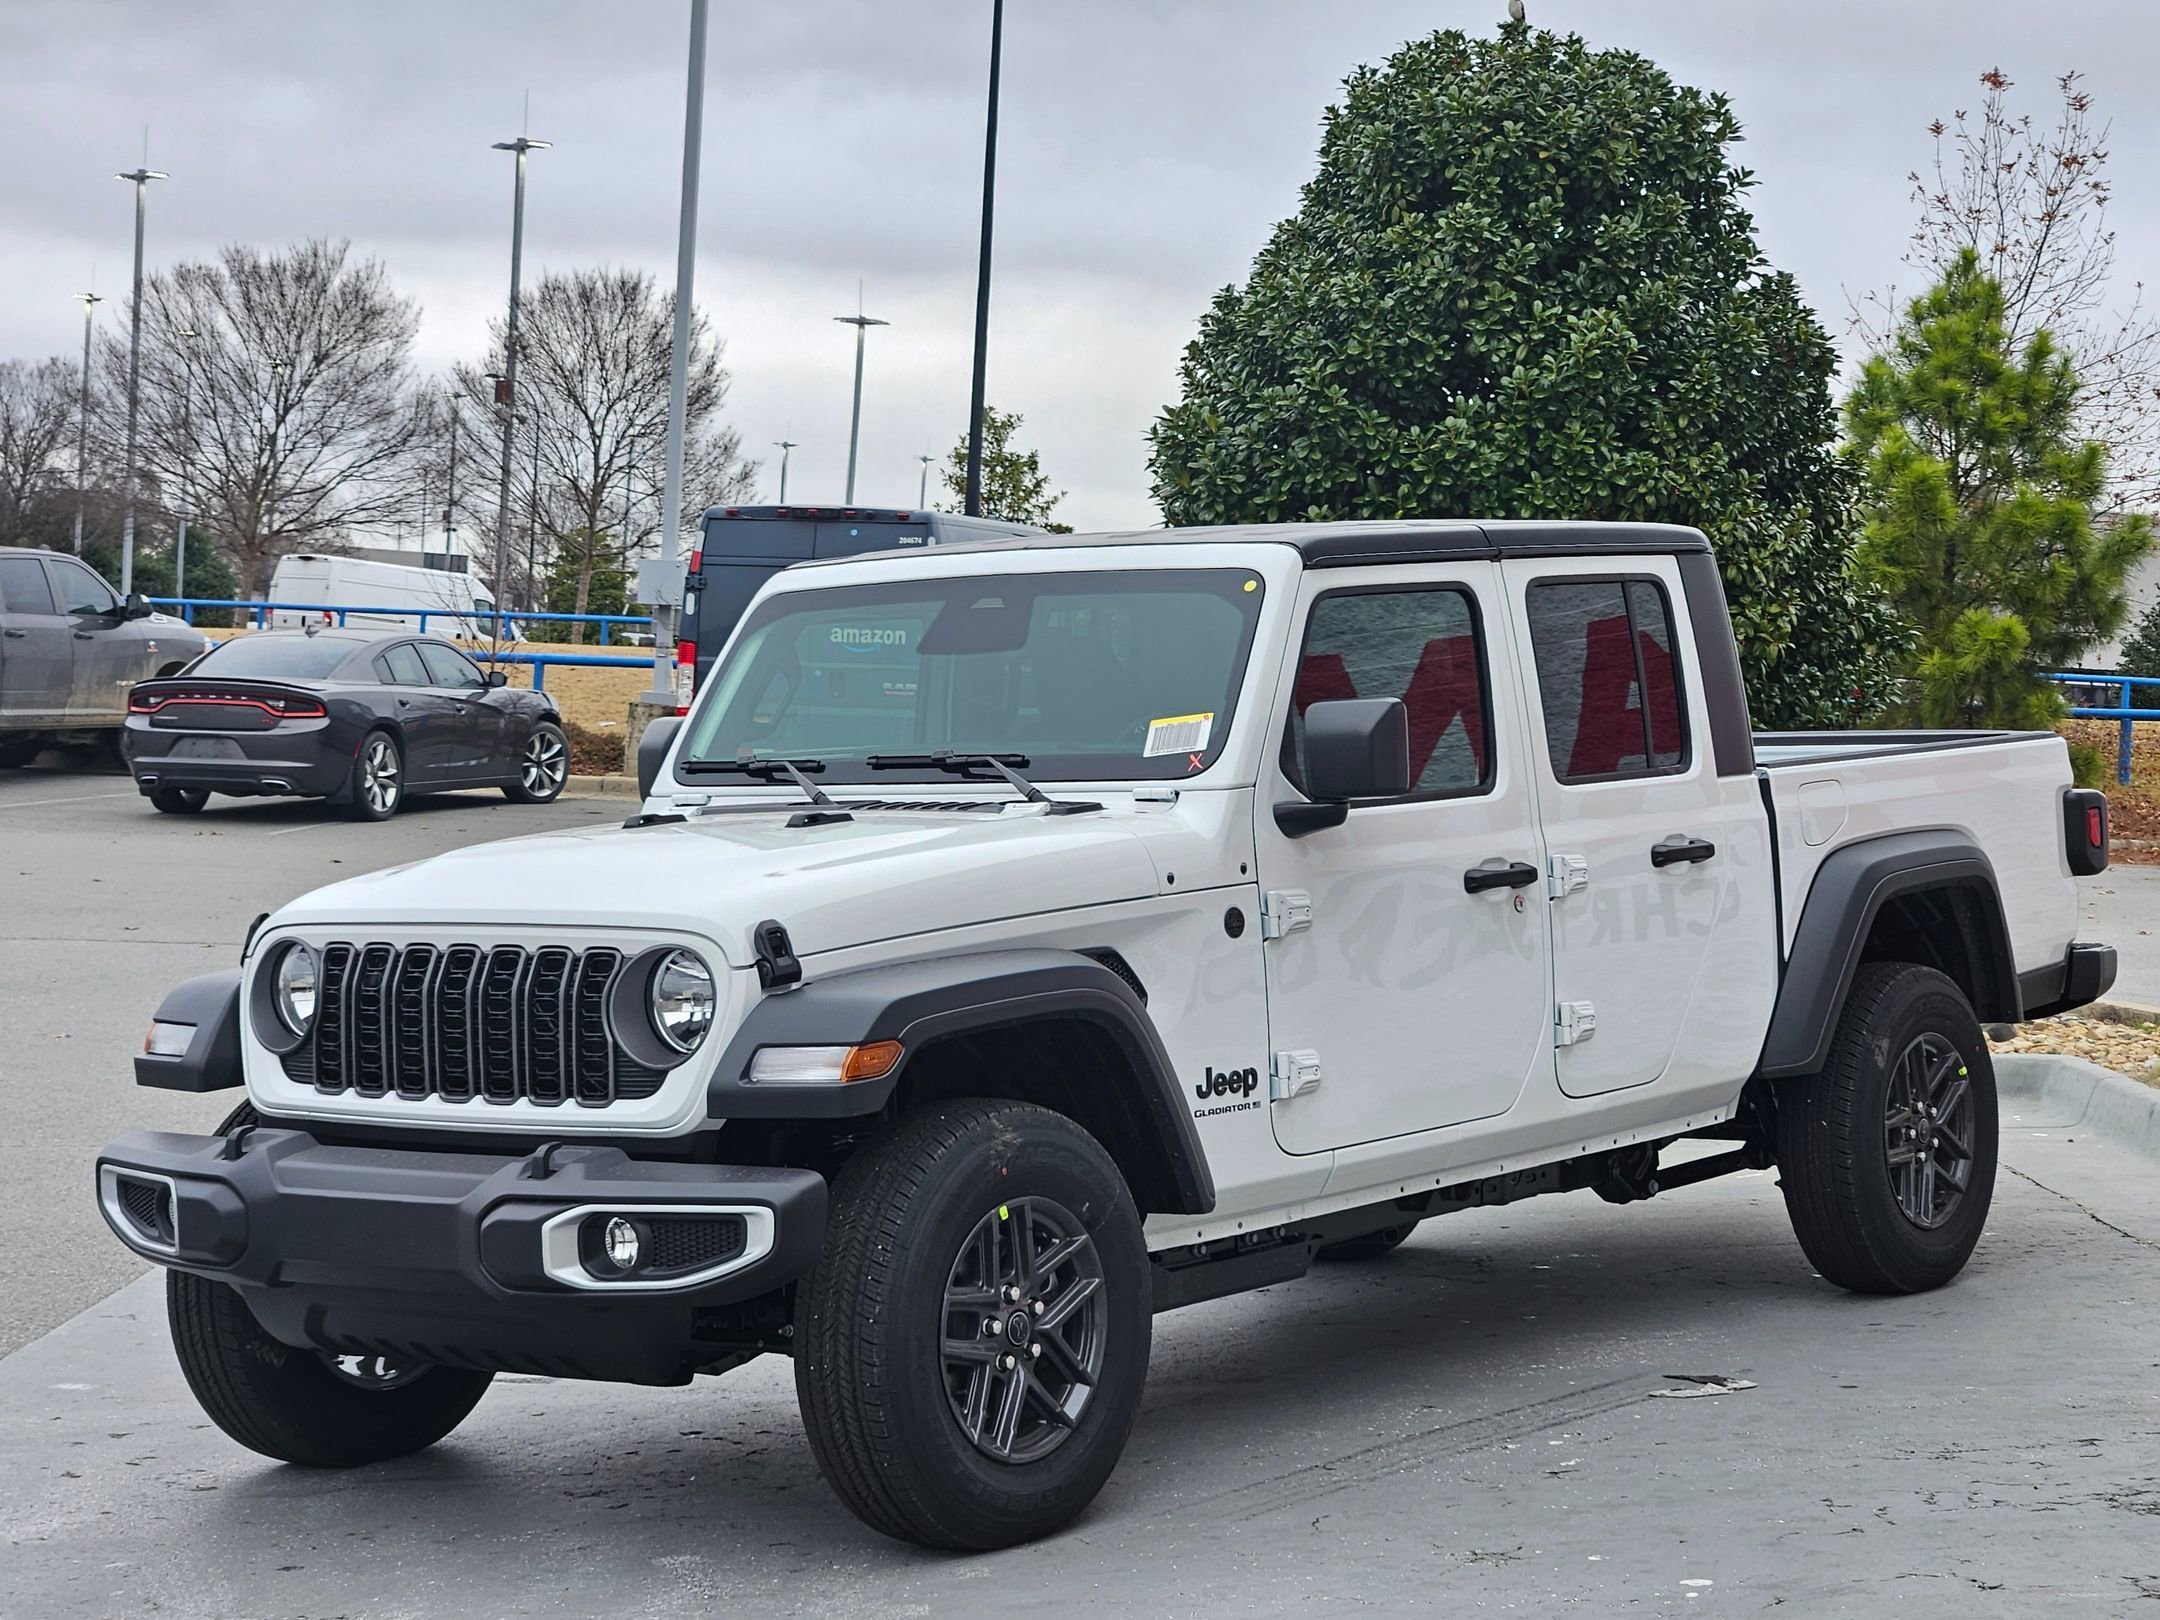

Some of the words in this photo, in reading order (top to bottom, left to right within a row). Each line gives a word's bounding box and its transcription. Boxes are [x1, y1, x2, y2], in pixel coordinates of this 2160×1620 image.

[830, 627, 906, 645] amazon
[1196, 1066, 1258, 1099] Jeep
[1194, 1102, 1252, 1118] GLADIATOR
